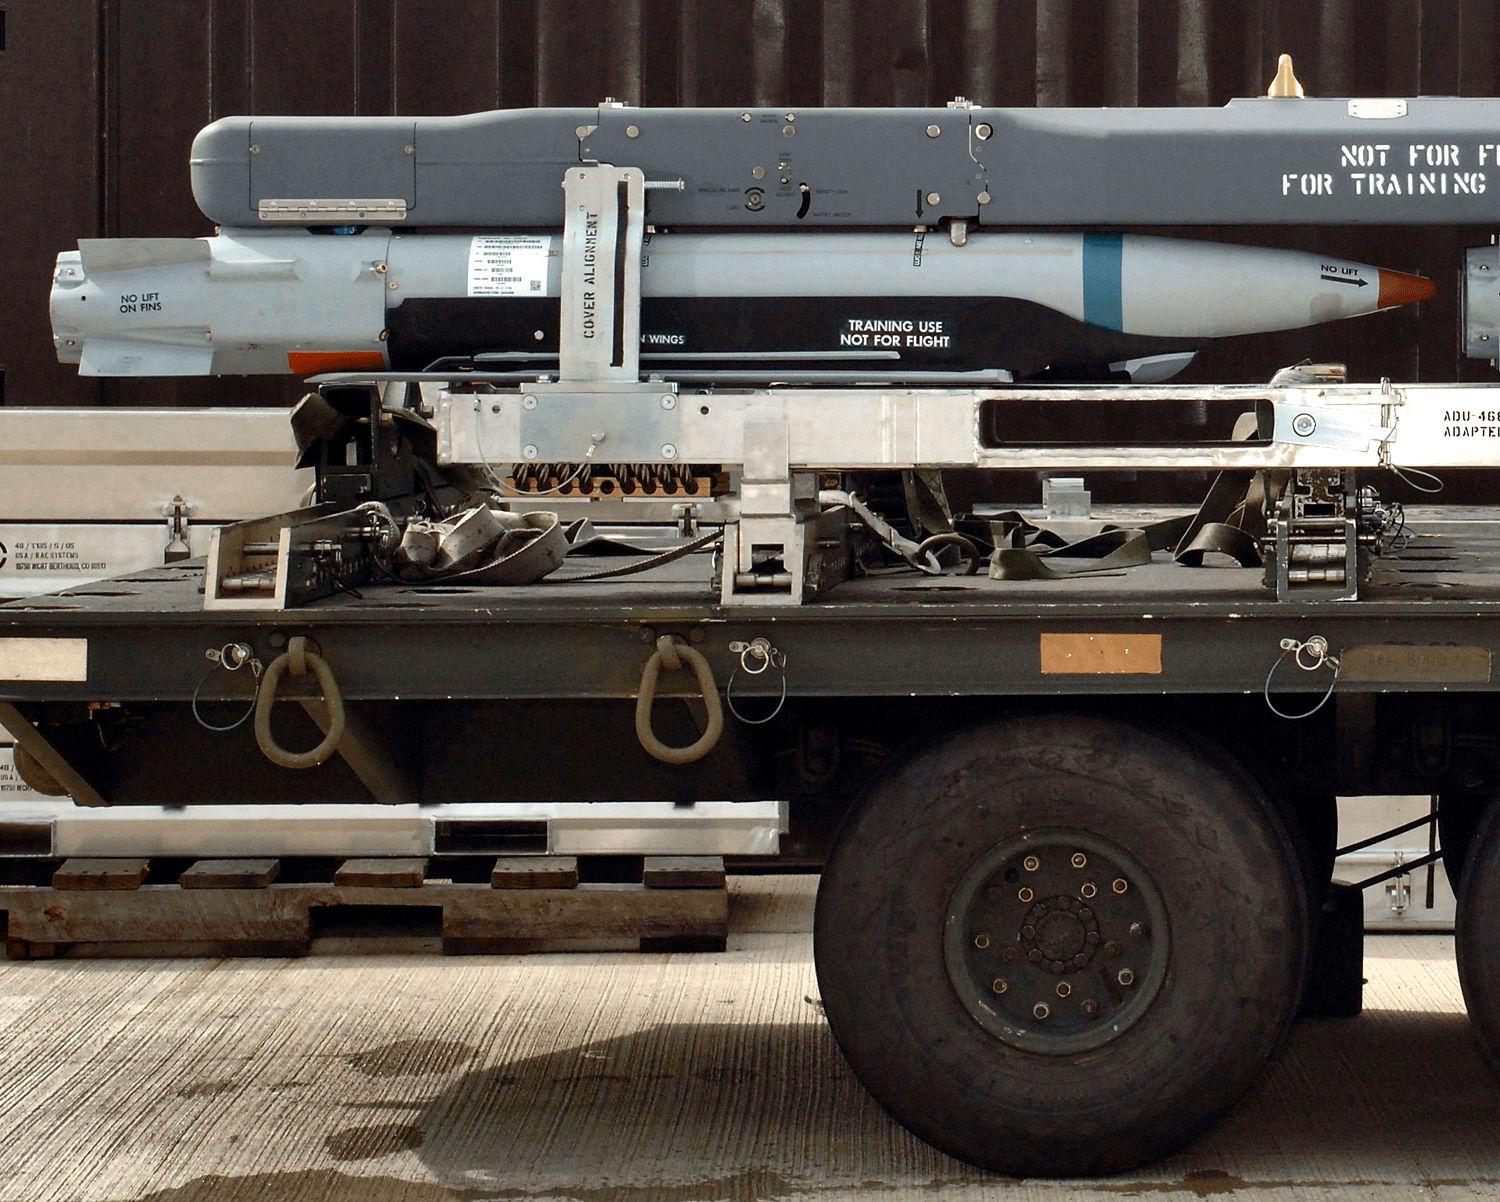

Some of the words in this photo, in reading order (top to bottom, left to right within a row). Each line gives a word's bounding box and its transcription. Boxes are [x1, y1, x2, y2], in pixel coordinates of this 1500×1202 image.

[1341, 144, 1390, 167] NOT
[1409, 144, 1460, 167] FOR
[1282, 173, 1333, 196] FOR
[1351, 172, 1487, 195] TRAINING
[584, 212, 598, 285] ALIGNMENT
[1321, 264, 1338, 273] NO
[1341, 267, 1358, 276] LIFT
[121, 294, 138, 303] NO
[142, 292, 159, 301] LIFT
[120, 304, 137, 313] ON
[140, 302, 162, 312] FINS
[583, 292, 595, 339] COVER
[848, 319, 914, 332] TRAINING
[918, 321, 943, 333] USE
[649, 334, 685, 345] WINGS
[840, 334, 870, 346] NOT
[874, 334, 901, 346] FOR
[906, 335, 950, 347] FLIGHT
